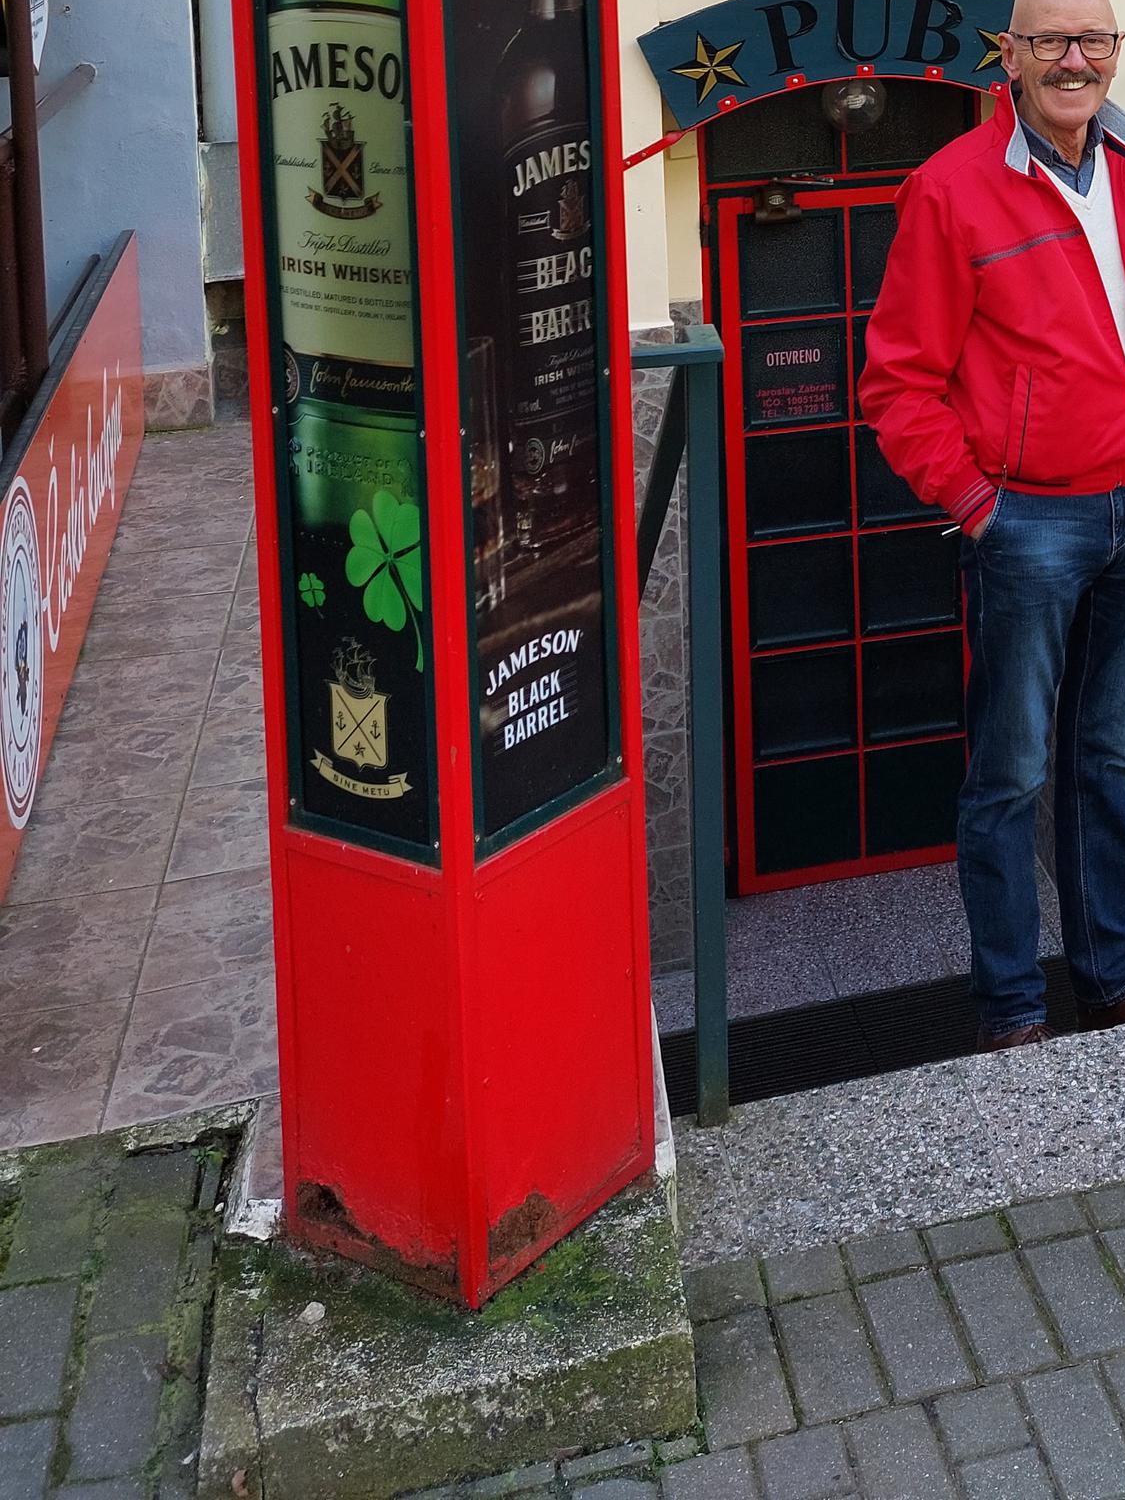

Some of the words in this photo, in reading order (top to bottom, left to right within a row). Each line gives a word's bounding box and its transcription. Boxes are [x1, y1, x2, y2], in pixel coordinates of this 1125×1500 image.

[271, 43, 402, 101] AMESO
[513, 140, 591, 196] JAMES
[281, 256, 327, 277] IRISH
[332, 263, 411, 285] WHISKEY
[536, 247, 592, 290] BLAC
[531, 300, 591, 344] BARR
[534, 370, 564, 387] IRISH
[766, 348, 821, 367] OTEVRENO
[486, 629, 581, 696] JAMESON
[508, 668, 561, 718] BLACK
[504, 696, 570, 751] BARREL
[362, 786, 390, 797] METU
